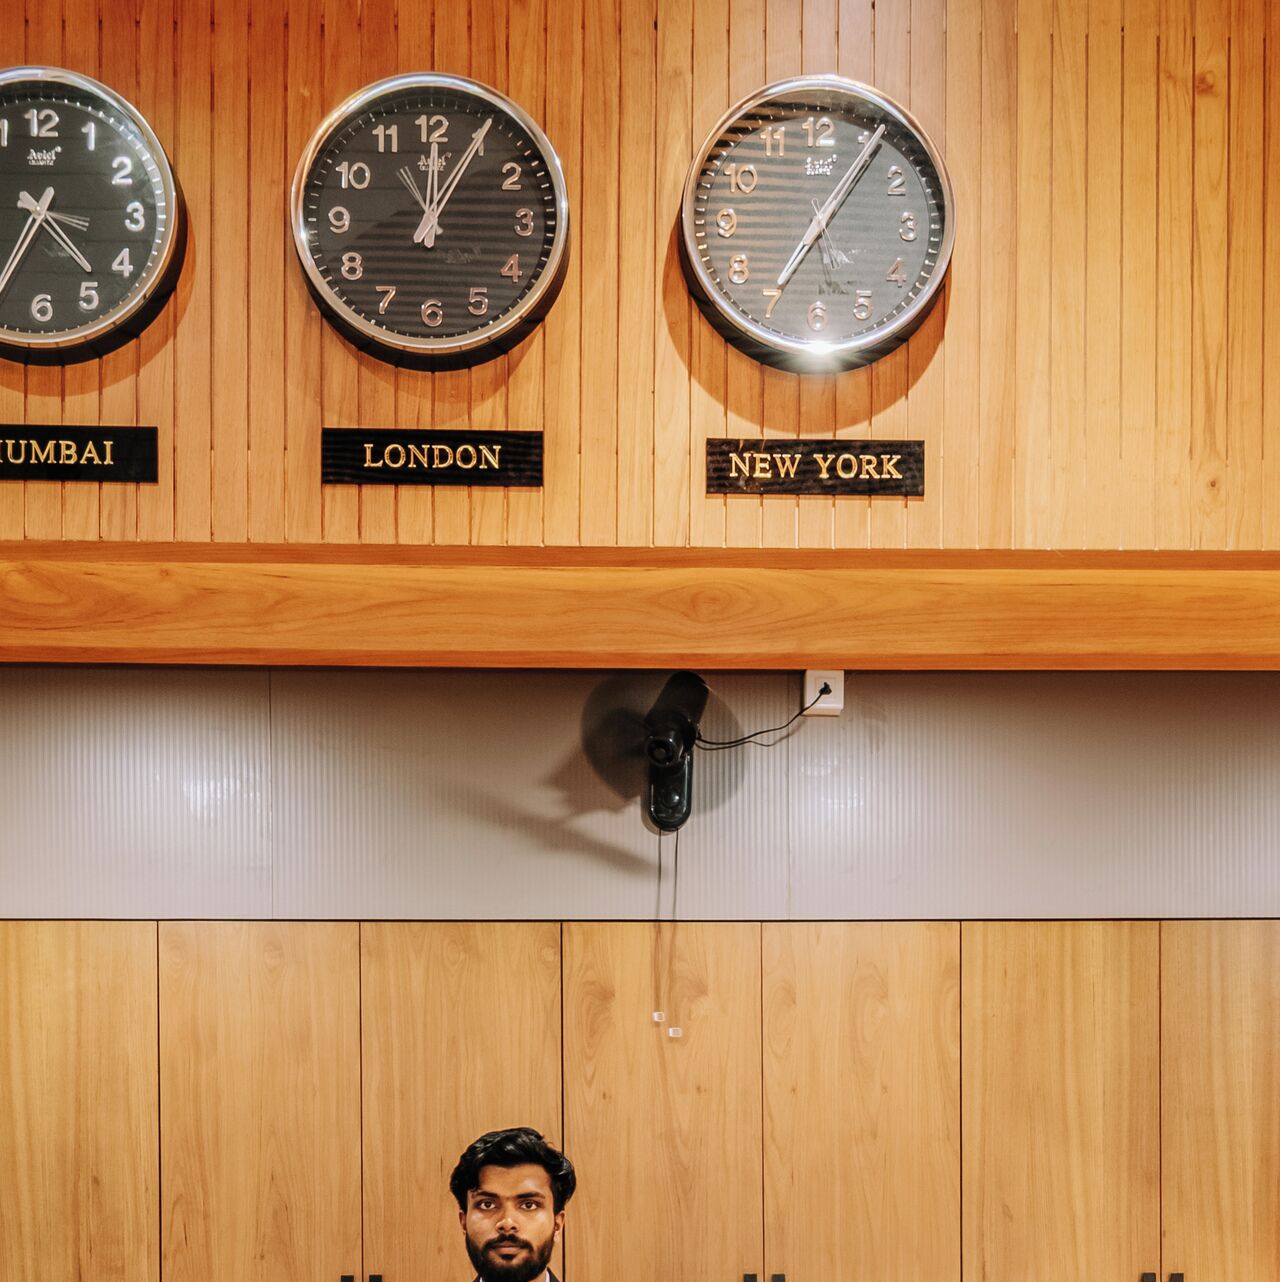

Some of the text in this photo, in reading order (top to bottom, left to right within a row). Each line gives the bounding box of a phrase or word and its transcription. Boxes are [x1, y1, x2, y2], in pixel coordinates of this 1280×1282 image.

[24, 109, 59, 137] 12
[82, 122, 95, 150] 1
[415, 114, 448, 142] 12
[802, 117, 834, 147] 12
[372, 124, 398, 152] 11
[760, 126, 785, 156] 11
[112, 156, 132, 184] 2
[336, 162, 370, 189] 10
[502, 162, 521, 190] 2
[724, 163, 758, 194] 10
[888, 165, 906, 196] 2
[125, 202, 144, 231] 3
[328, 206, 350, 233] 9
[514, 208, 533, 236] 3
[716, 208, 737, 238] 9
[899, 211, 916, 241] 3
[112, 248, 133, 277] 4
[341, 252, 362, 280] 8
[500, 254, 522, 282] 4
[728, 254, 750, 284] 8
[886, 258, 906, 287] 4
[32, 294, 53, 322] 6
[79, 282, 98, 310] 5
[376, 286, 396, 314] 7
[468, 288, 488, 315] 5
[762, 288, 781, 318] 7
[853, 290, 872, 320] 5
[421, 300, 443, 326] 6
[808, 301, 828, 331] 6
[363, 443, 502, 470] LONDON
[729, 451, 904, 480] NEW YORK
